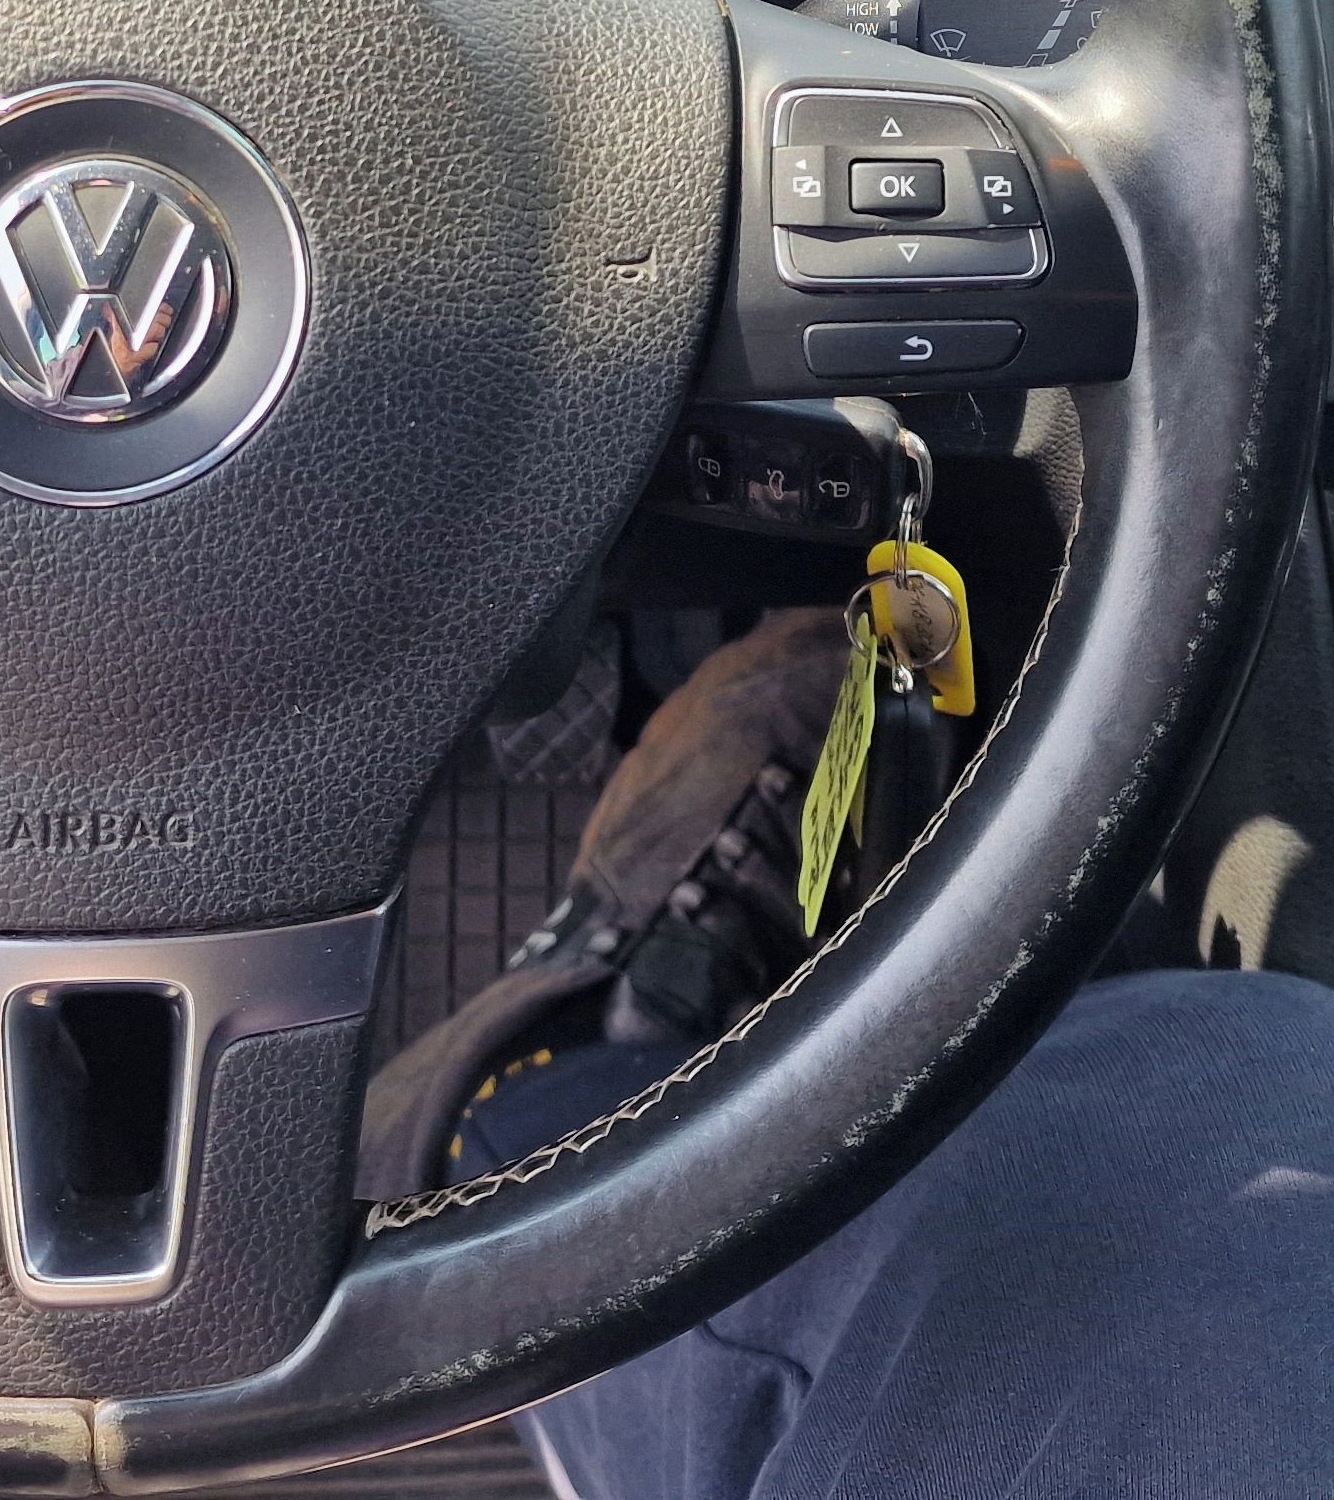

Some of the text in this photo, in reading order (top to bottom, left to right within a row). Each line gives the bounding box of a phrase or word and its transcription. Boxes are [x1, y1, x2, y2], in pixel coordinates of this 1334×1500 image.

[846, 2, 879, 16] HIGH
[879, 176, 917, 198] OK
[4, 808, 199, 853] AIRBAG
